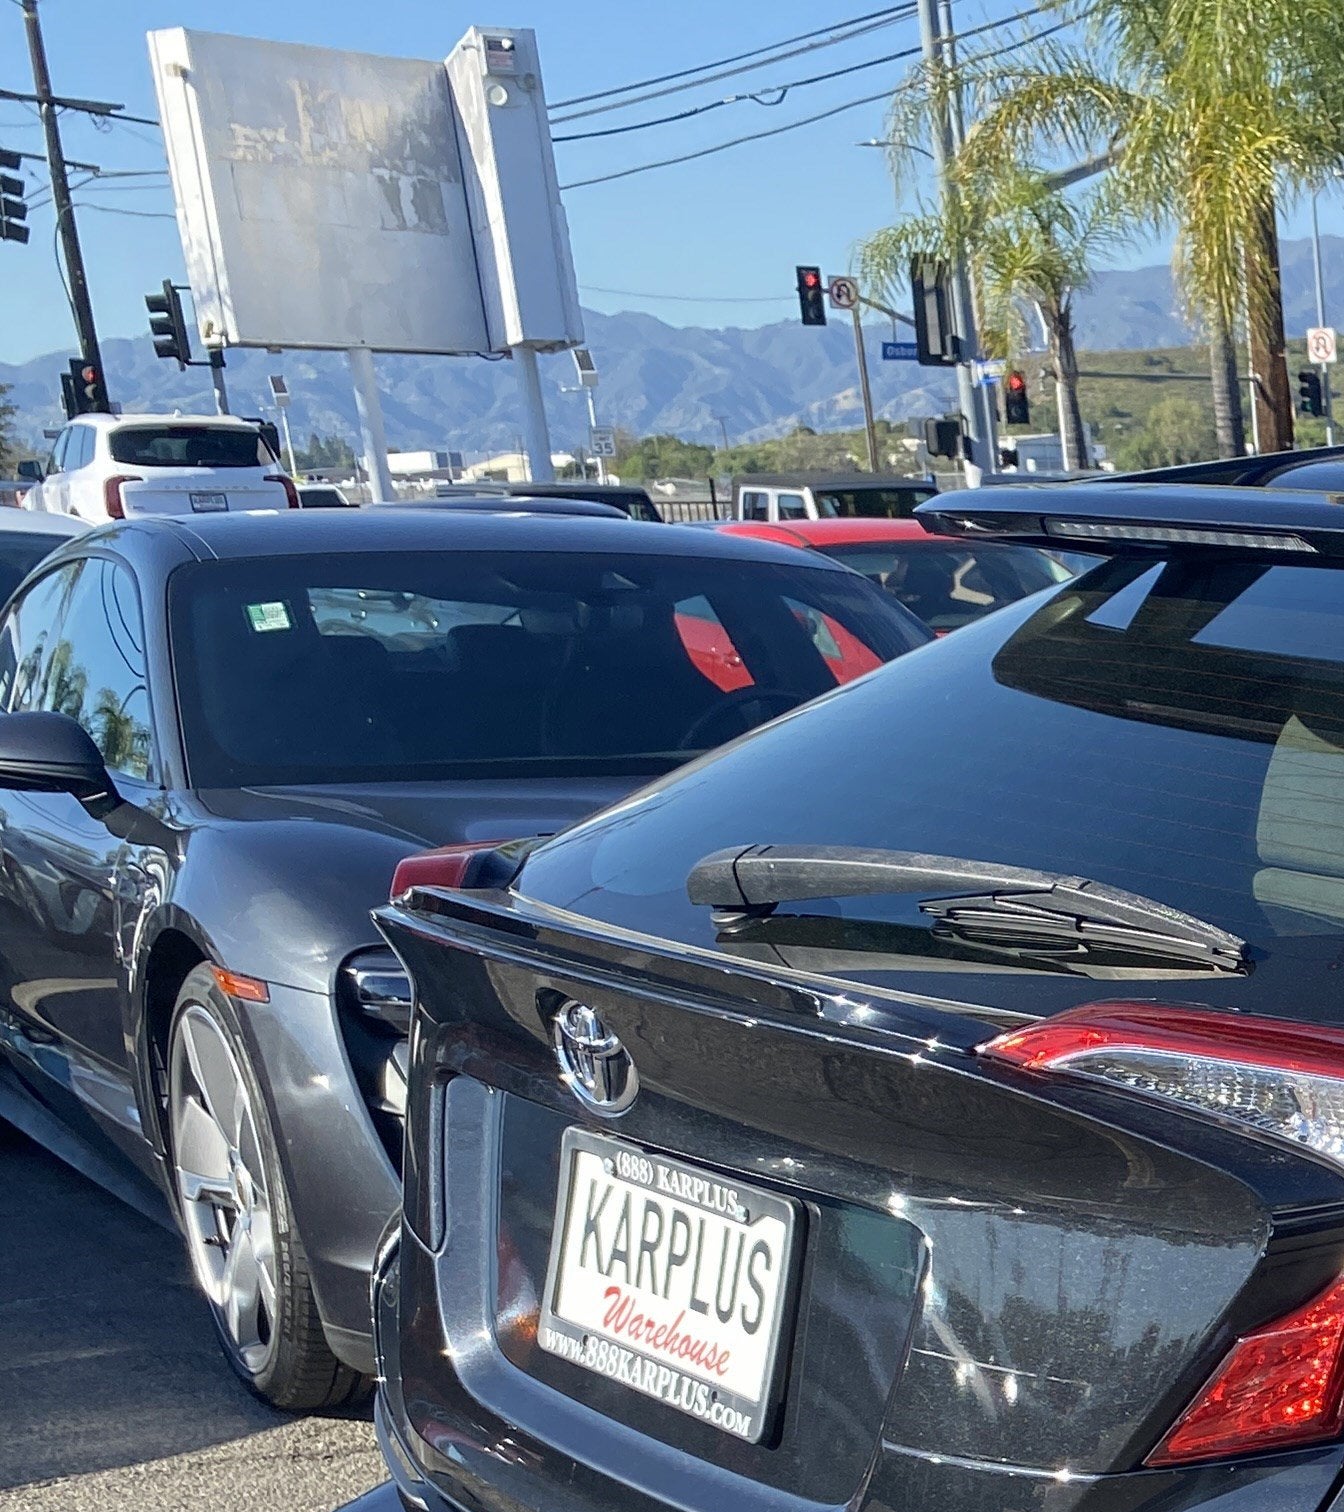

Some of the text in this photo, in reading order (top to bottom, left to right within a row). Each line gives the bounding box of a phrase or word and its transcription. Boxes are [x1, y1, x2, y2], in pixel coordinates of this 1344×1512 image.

[594, 442, 614, 454] 35
[616, 1150, 739, 1216] (888) KARPLUS
[579, 1178, 773, 1335] KARPLUS
[602, 1286, 731, 1377] Warehouse
